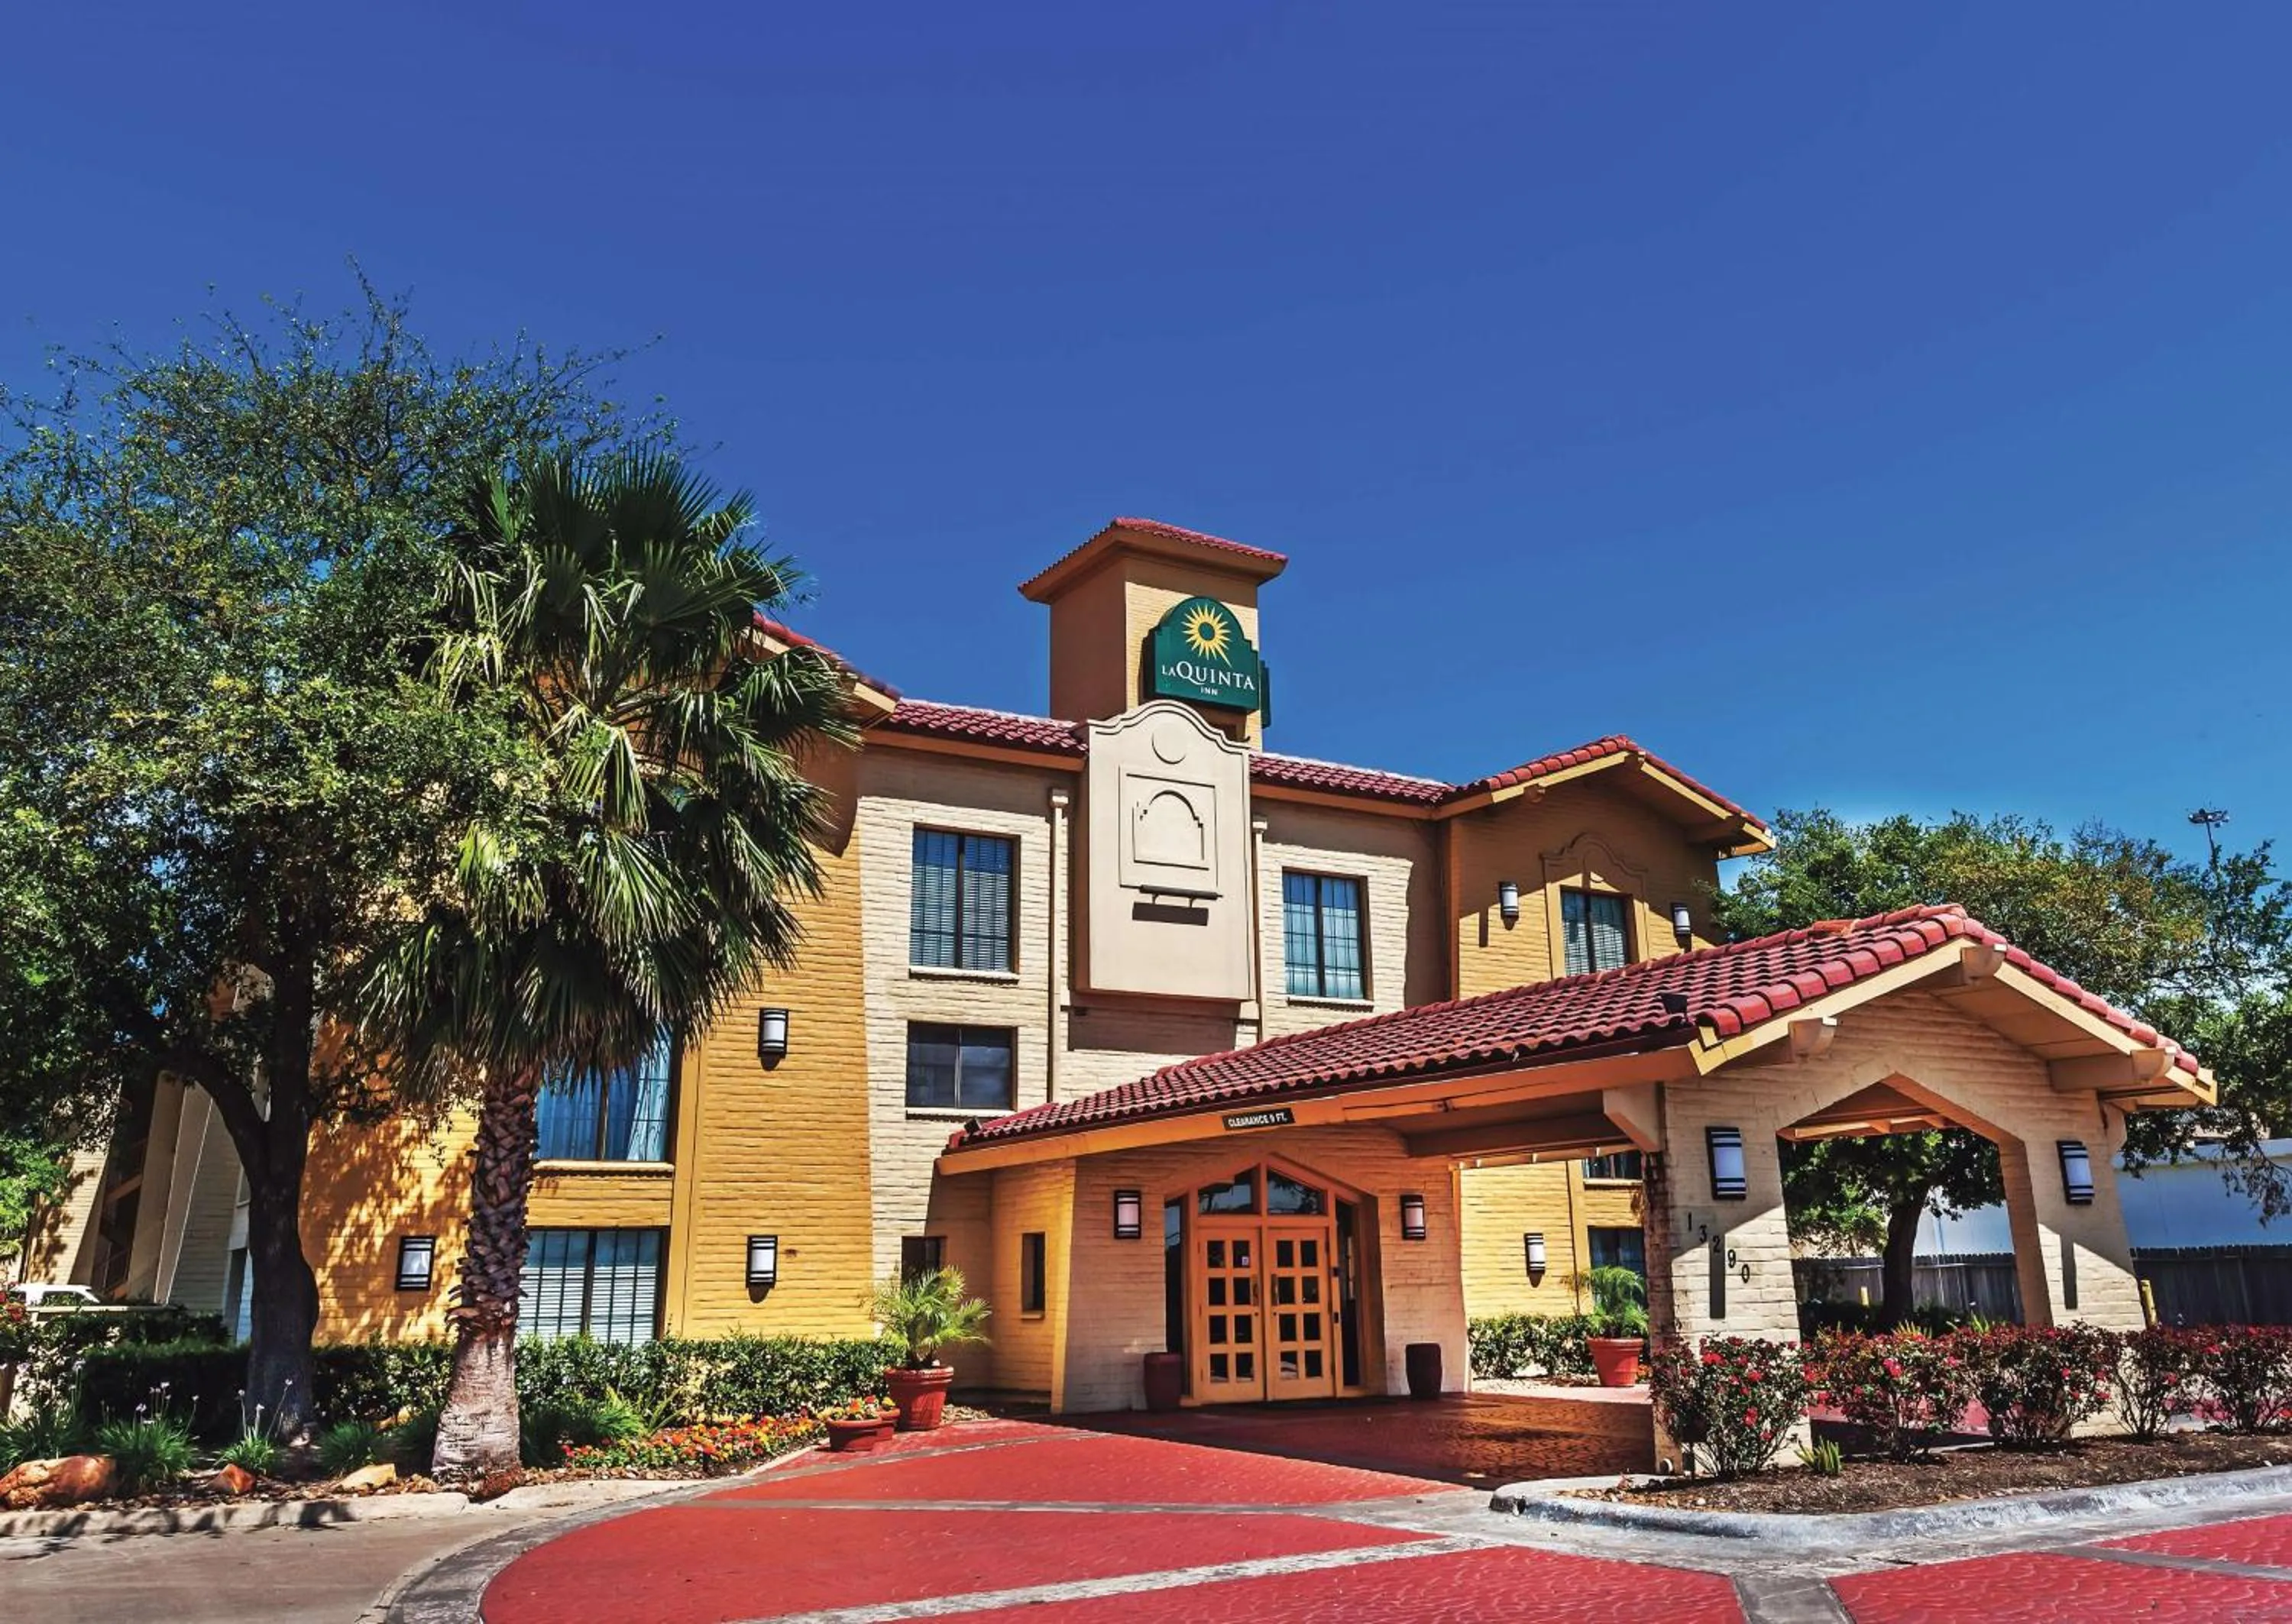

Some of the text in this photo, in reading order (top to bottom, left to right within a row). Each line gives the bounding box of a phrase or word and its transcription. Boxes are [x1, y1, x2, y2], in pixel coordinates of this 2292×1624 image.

[1162, 661, 1255, 691] LA QUINTA
[1200, 687, 1218, 695] INN
[1228, 1114, 1269, 1127] CLEARANCE
[1688, 1212, 1750, 1283] 13290
